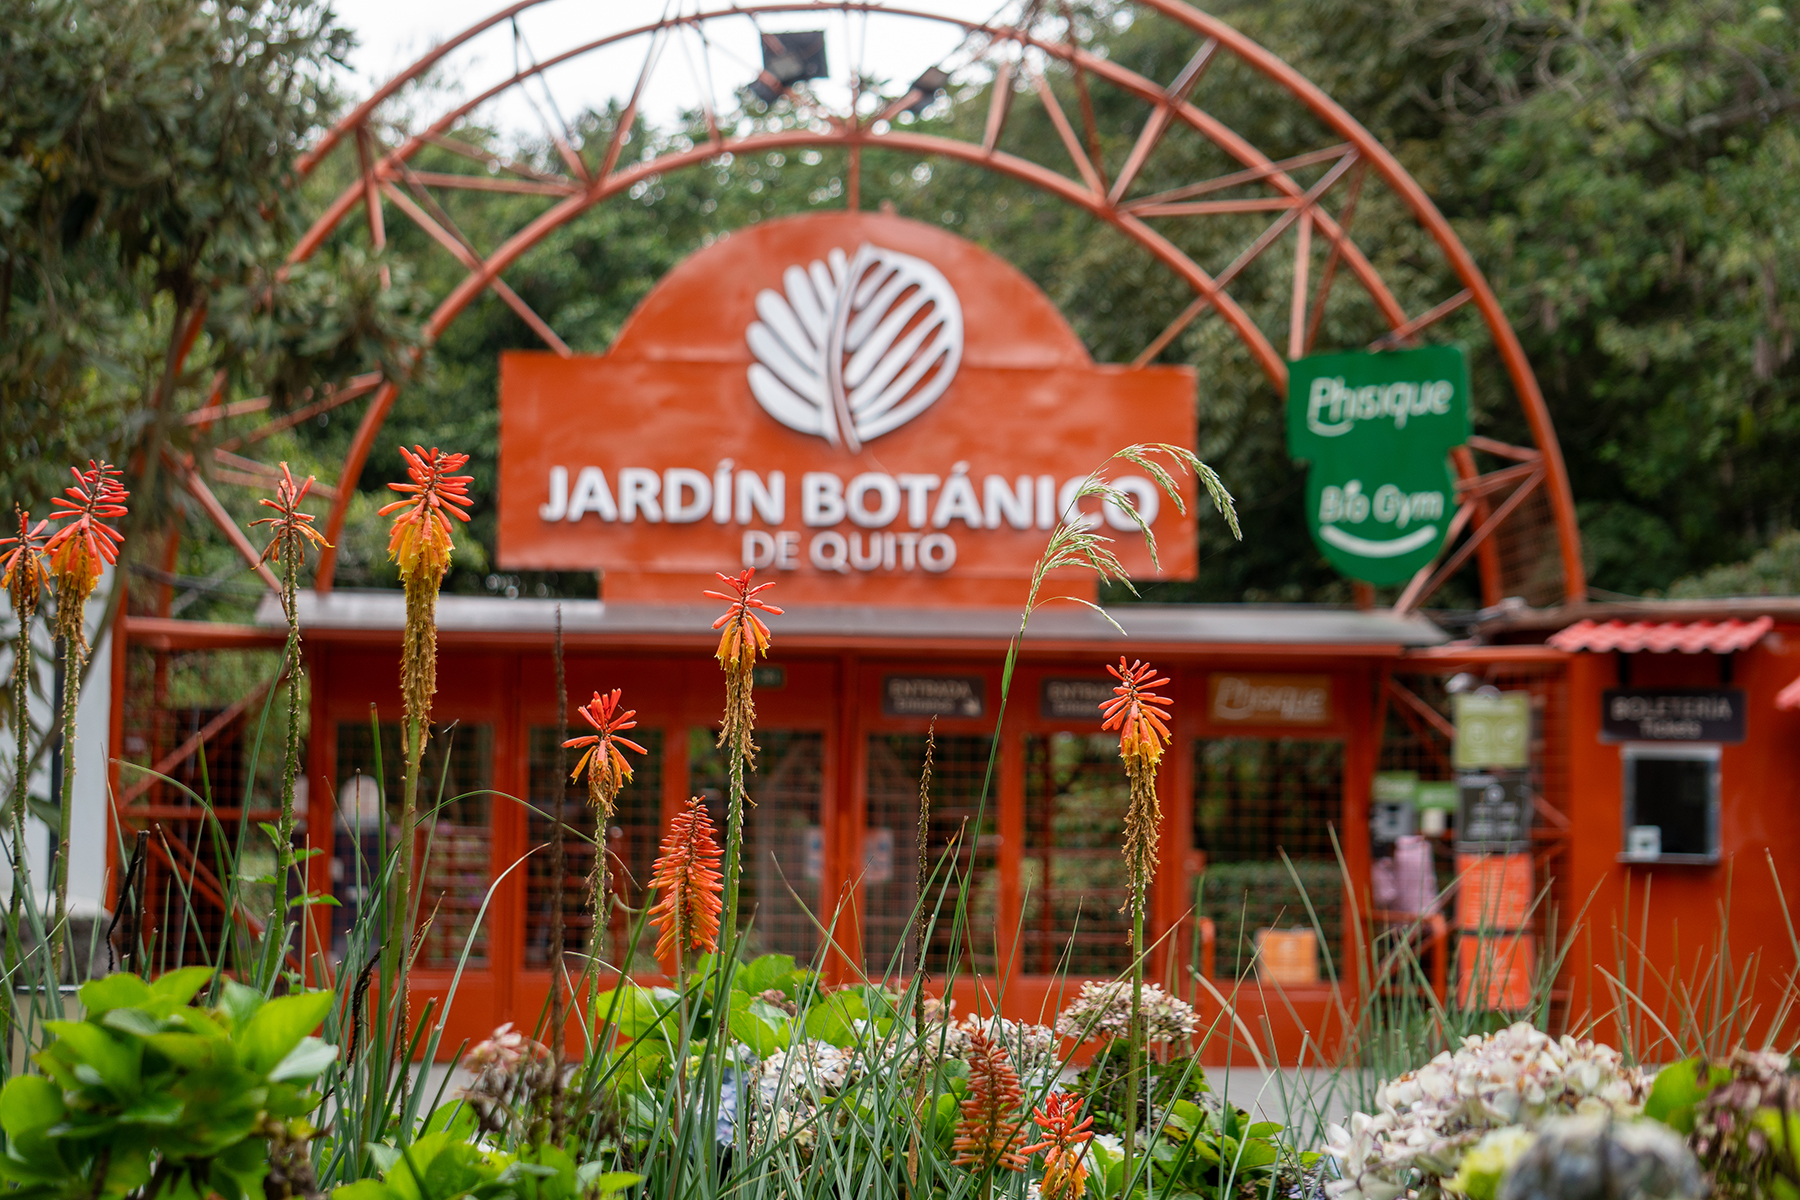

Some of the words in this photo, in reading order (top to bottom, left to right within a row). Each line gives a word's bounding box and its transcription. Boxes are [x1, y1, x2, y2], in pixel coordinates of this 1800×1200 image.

[539, 458, 786, 525] JARDÍN
[802, 460, 1161, 532] BOTÁNICO
[1319, 479, 1371, 523] Bio
[1372, 484, 1445, 529] Gym
[741, 530, 801, 570] DE
[809, 530, 958, 573] QUITO
[889, 680, 971, 698] ENTRADA
